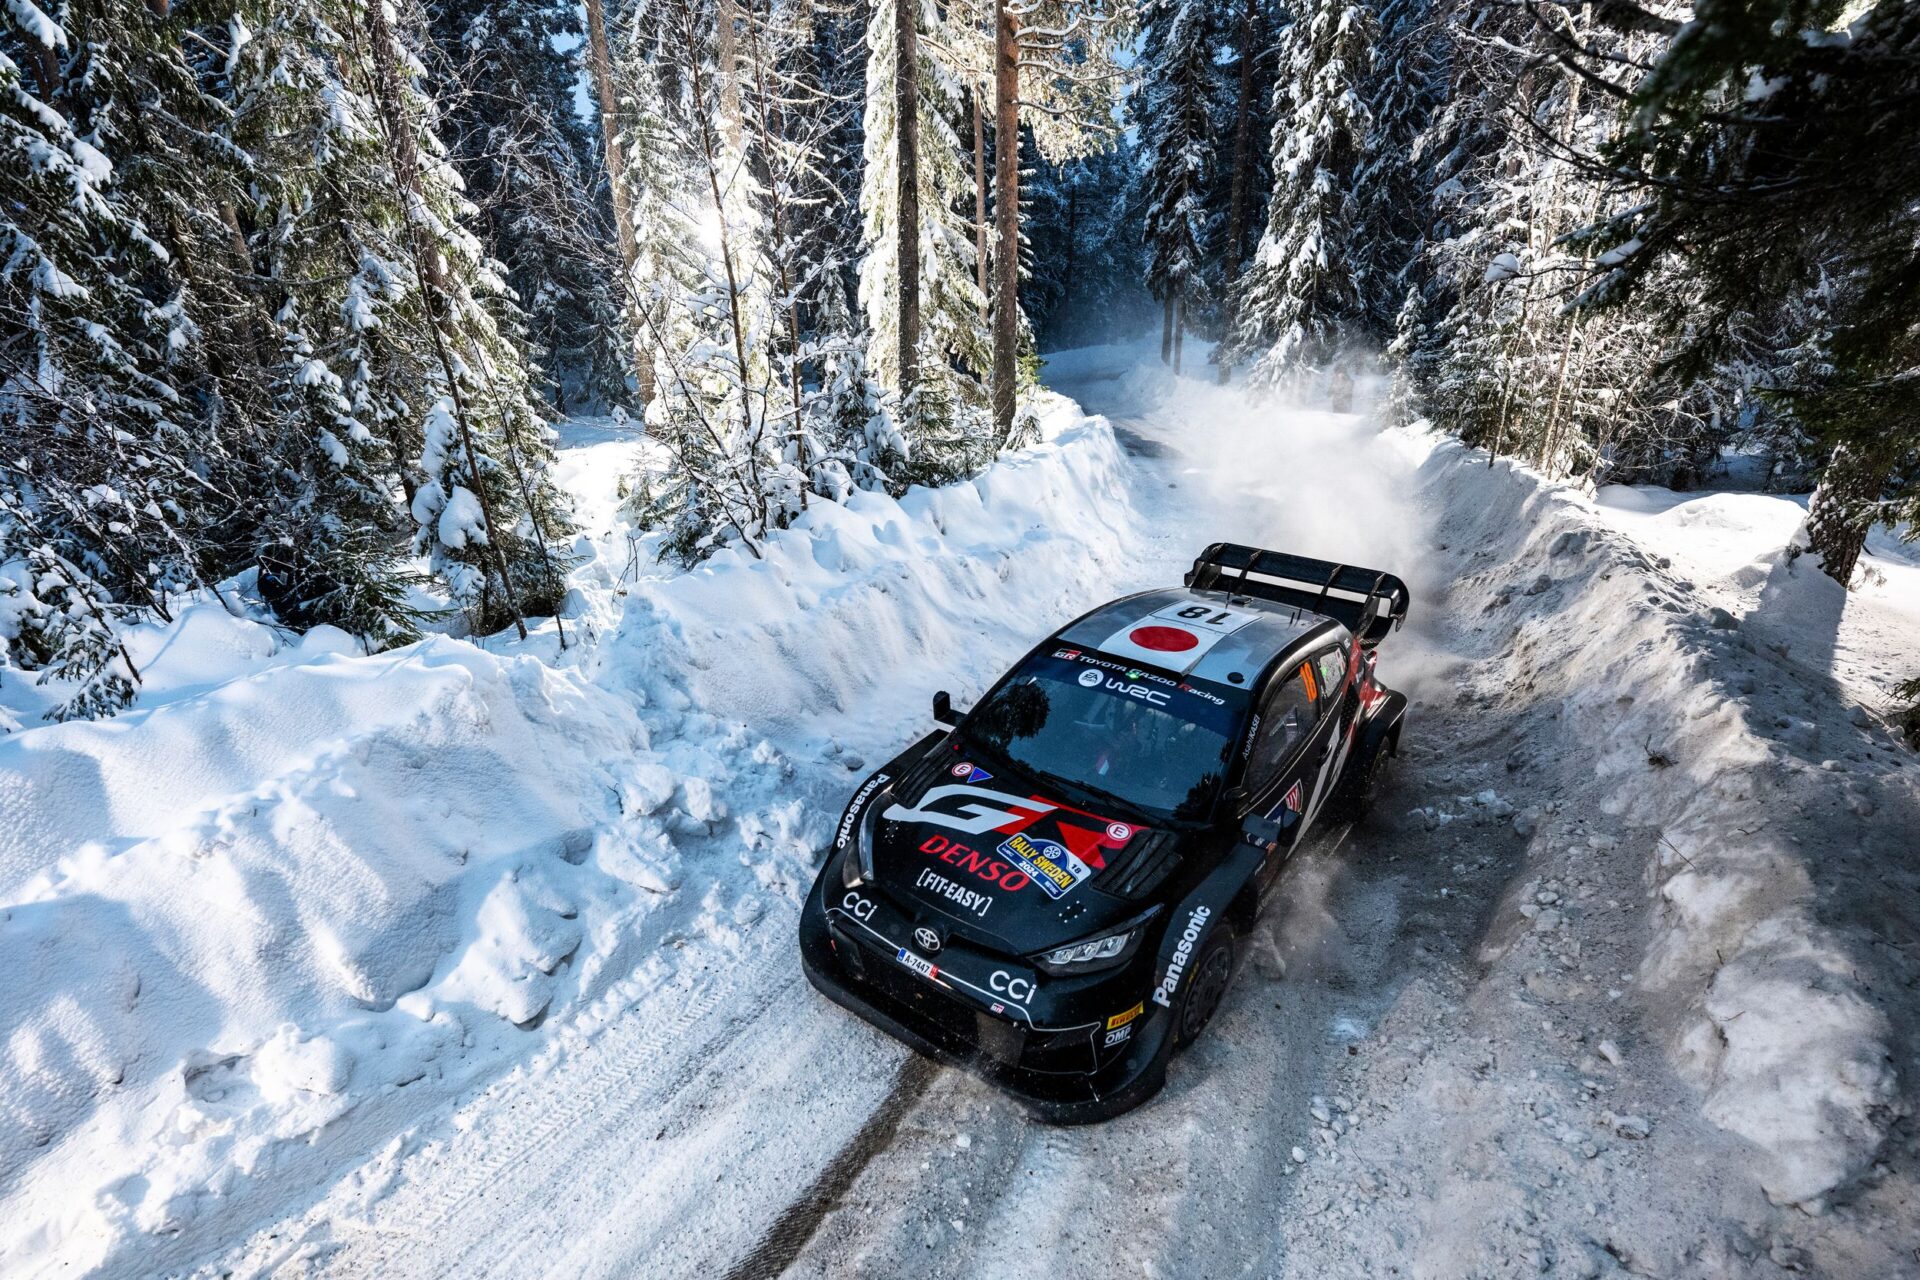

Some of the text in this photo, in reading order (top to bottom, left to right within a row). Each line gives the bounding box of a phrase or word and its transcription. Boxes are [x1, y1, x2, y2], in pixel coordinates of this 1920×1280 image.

[1177, 606, 1232, 625] 18
[1053, 650, 1226, 706] GR TOYOTA GAZOO Racing
[1105, 677, 1171, 706] WRC
[1300, 662, 1317, 704] 18
[837, 774, 890, 849] Panasonic
[919, 835, 1030, 891] DENSO
[1009, 836, 1039, 859] RALLY
[1033, 856, 1074, 888] SWEDEN
[1019, 860, 1039, 877] 2024
[1071, 864, 1082, 874] 18
[905, 955, 930, 973] A-7447
[1152, 905, 1211, 1008] Panasonic
[1105, 1026, 1132, 1044] OMP
